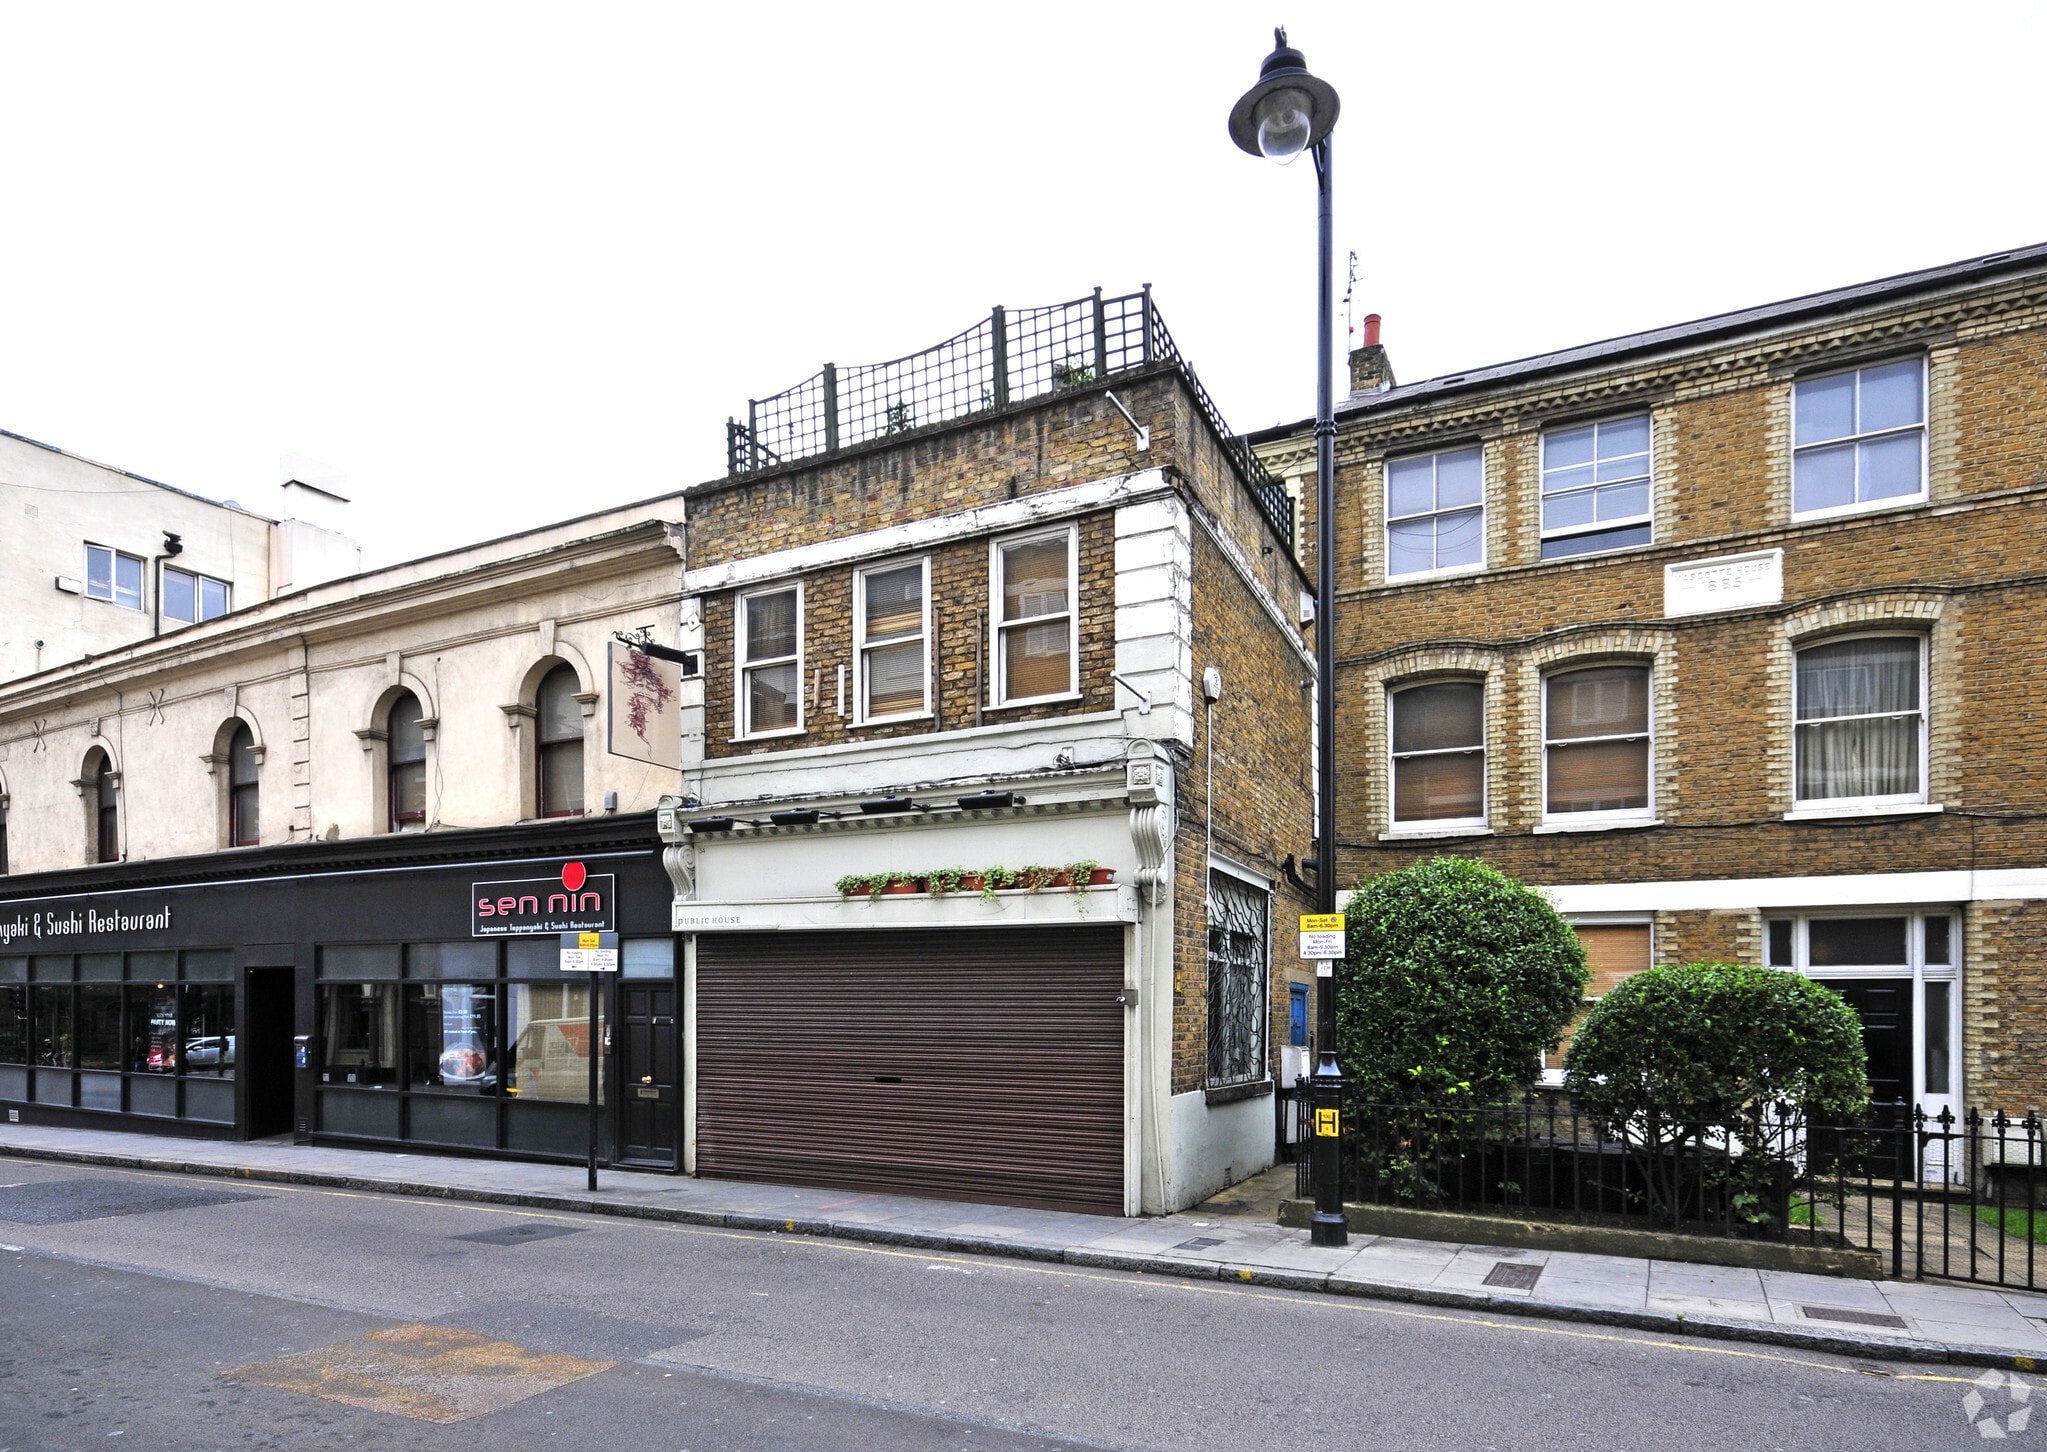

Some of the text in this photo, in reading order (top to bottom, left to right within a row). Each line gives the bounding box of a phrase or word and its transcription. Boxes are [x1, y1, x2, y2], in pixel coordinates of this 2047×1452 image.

[479, 892, 600, 917] sen nin
[33, 913, 42, 939] &
[47, 911, 82, 935] Sushi
[88, 905, 172, 933] Restaurant
[480, 924, 508, 934] Japanese
[544, 921, 549, 931] &
[551, 920, 568, 930] Sushi
[570, 920, 605, 930] Restaurant
[712, 916, 741, 924] HOUSE
